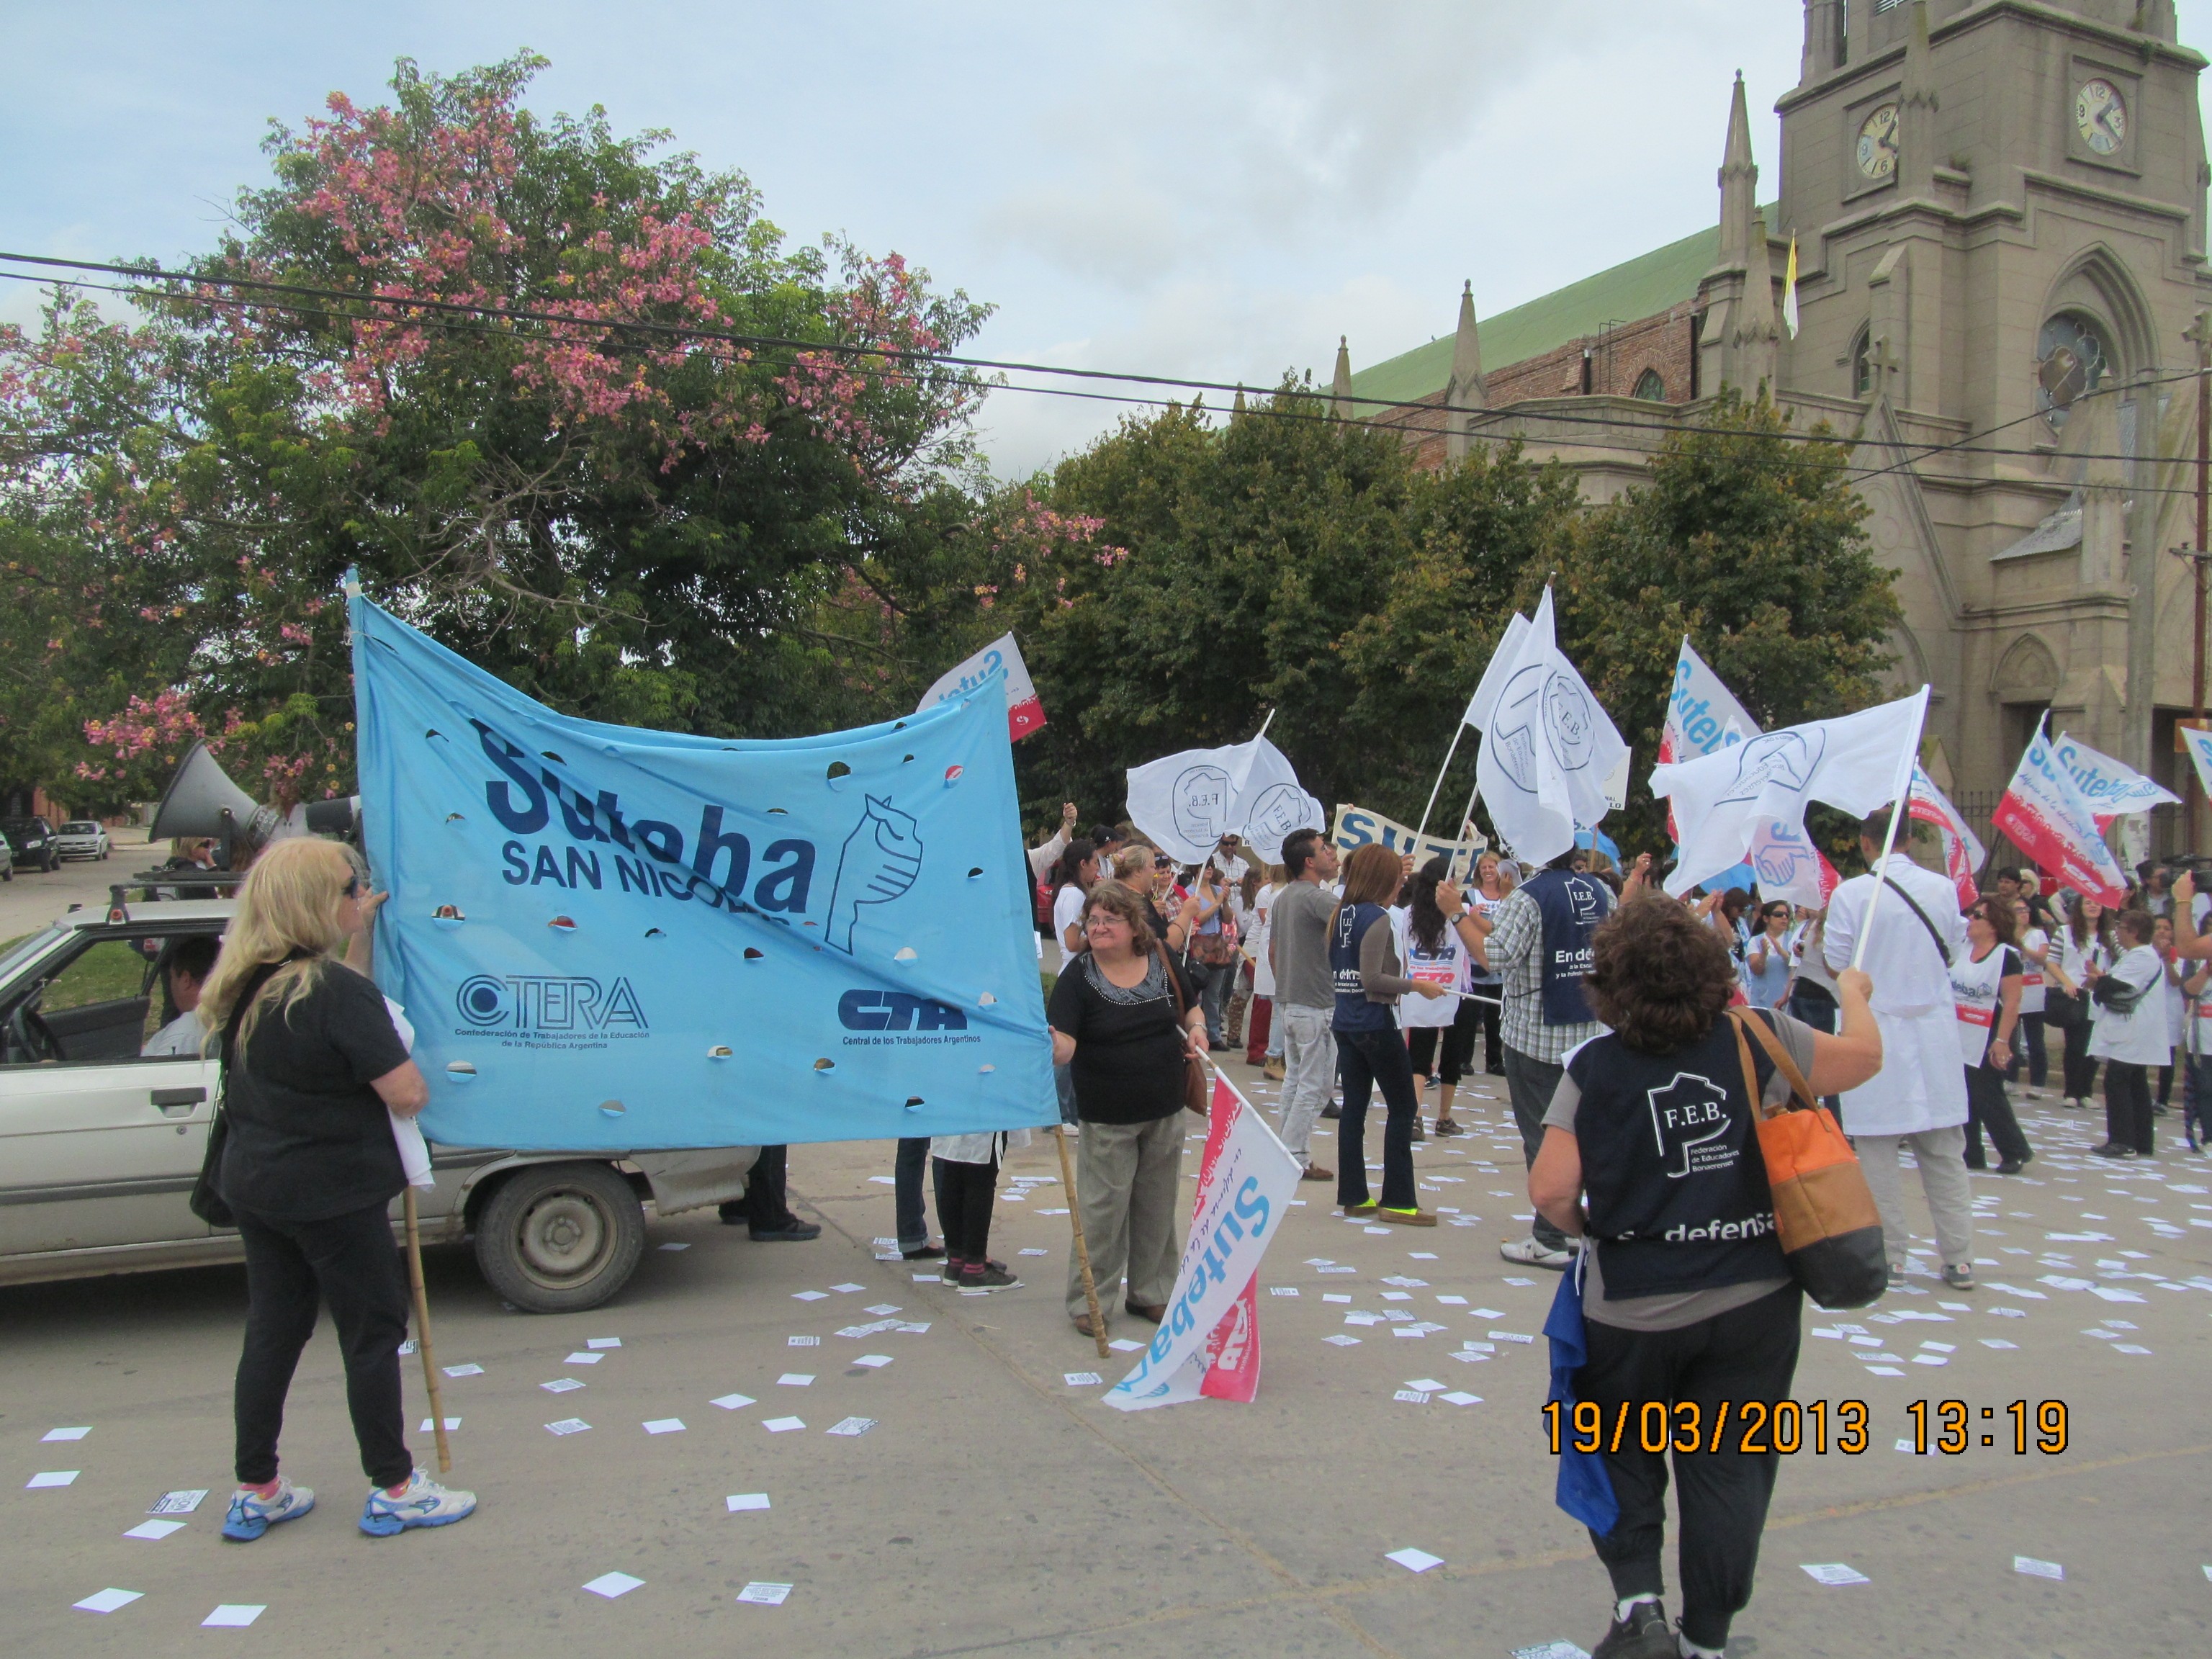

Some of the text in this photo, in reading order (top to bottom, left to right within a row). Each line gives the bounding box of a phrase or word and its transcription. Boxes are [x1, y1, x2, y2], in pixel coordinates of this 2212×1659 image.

[502, 840, 603, 890] SAN
[1555, 950, 1573, 963] En
[456, 974, 649, 1030] CTERA
[837, 989, 968, 1031] CTA
[455, 1028, 518, 1038] Confederación
[533, 1032, 587, 1040] Trabajadores
[610, 1030, 649, 1039] Educación
[842, 1036, 870, 1045] Central
[896, 1036, 943, 1046] Trabajadores
[944, 1035, 981, 1046] Argentinos
[525, 1041, 567, 1050] República
[569, 1041, 608, 1051] Argentina
[1664, 1102, 1727, 1128] F.E.B.
[1691, 1144, 1727, 1155] Federación
[1701, 1150, 1740, 1161] Educadores
[1150, 1175, 1270, 1365] Suteba
